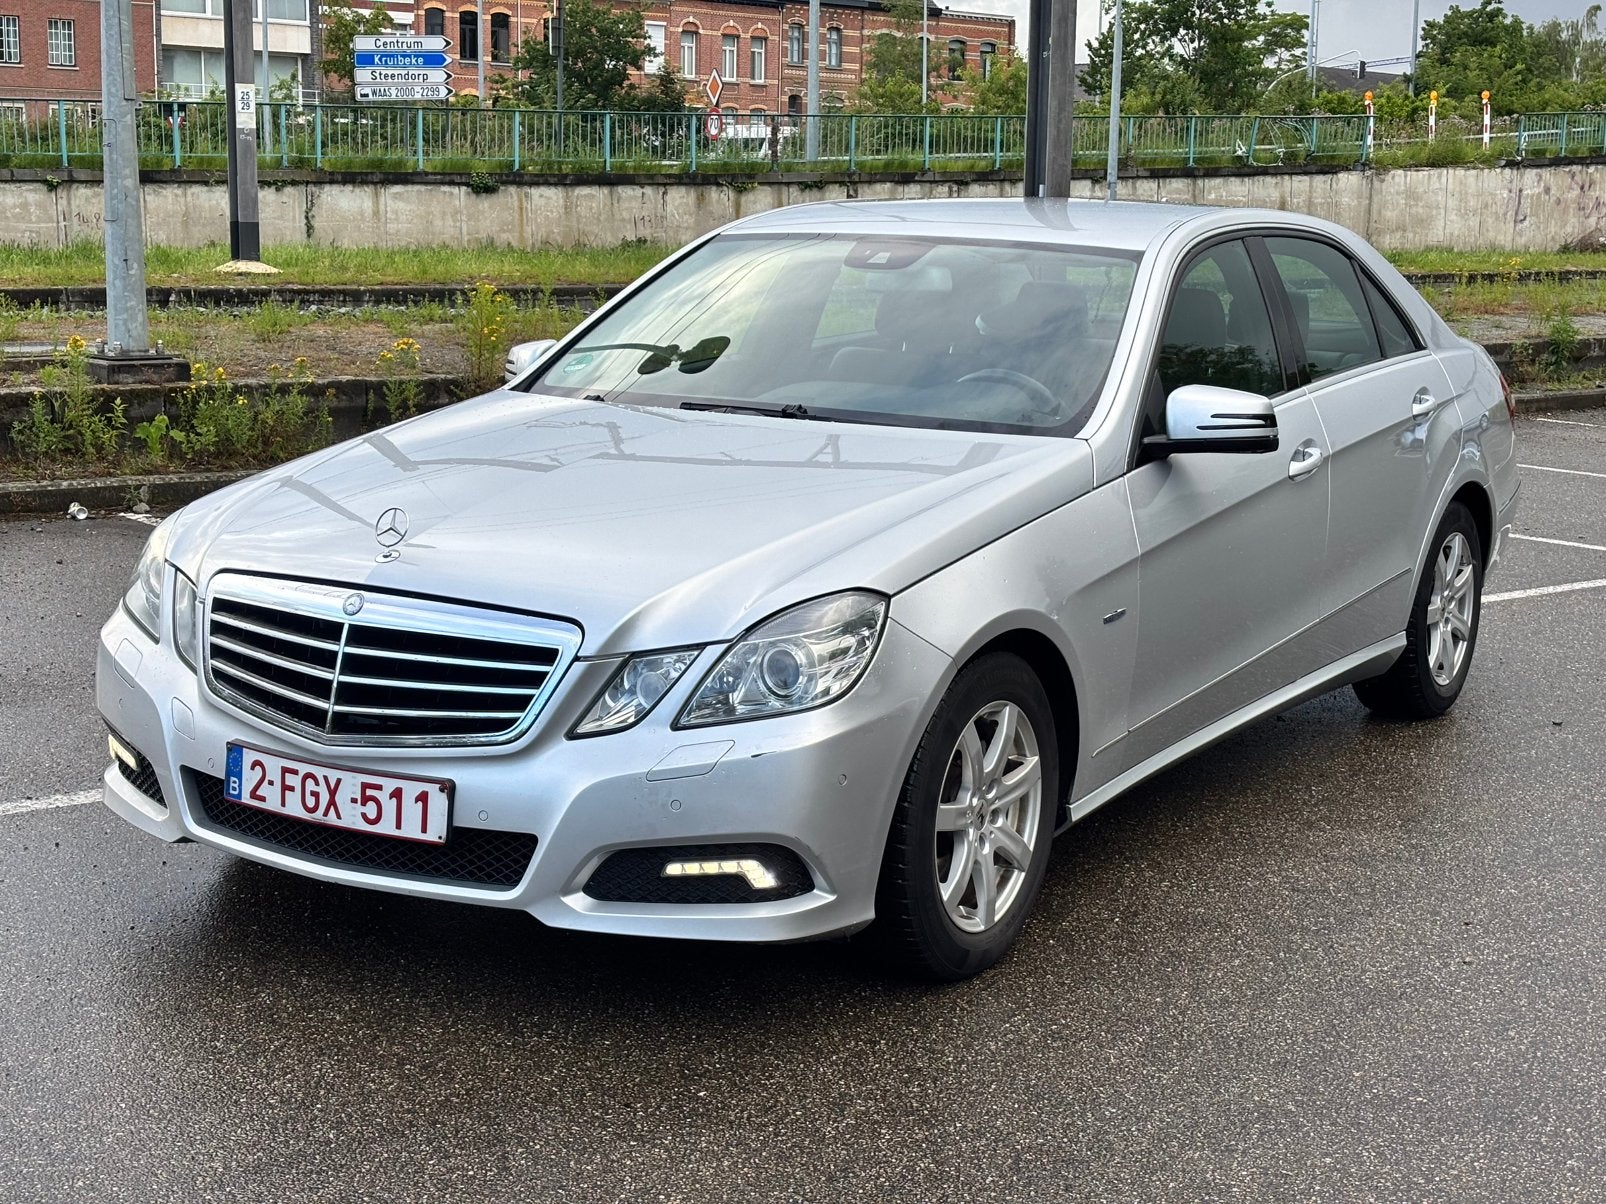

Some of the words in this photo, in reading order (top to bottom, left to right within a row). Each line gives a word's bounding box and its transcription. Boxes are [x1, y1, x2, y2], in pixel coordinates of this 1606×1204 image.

[374, 38, 423, 49] Centrum
[374, 54, 424, 65] Kruibeke
[370, 70, 429, 83] Steendorp
[240, 91, 250, 100] 25
[370, 87, 392, 98] WAAS
[395, 86, 440, 97] 2000-2299
[240, 101, 251, 111] 29
[709, 117, 719, 130] 70
[229, 777, 240, 795] B
[249, 759, 429, 834] 2-FGX-511
